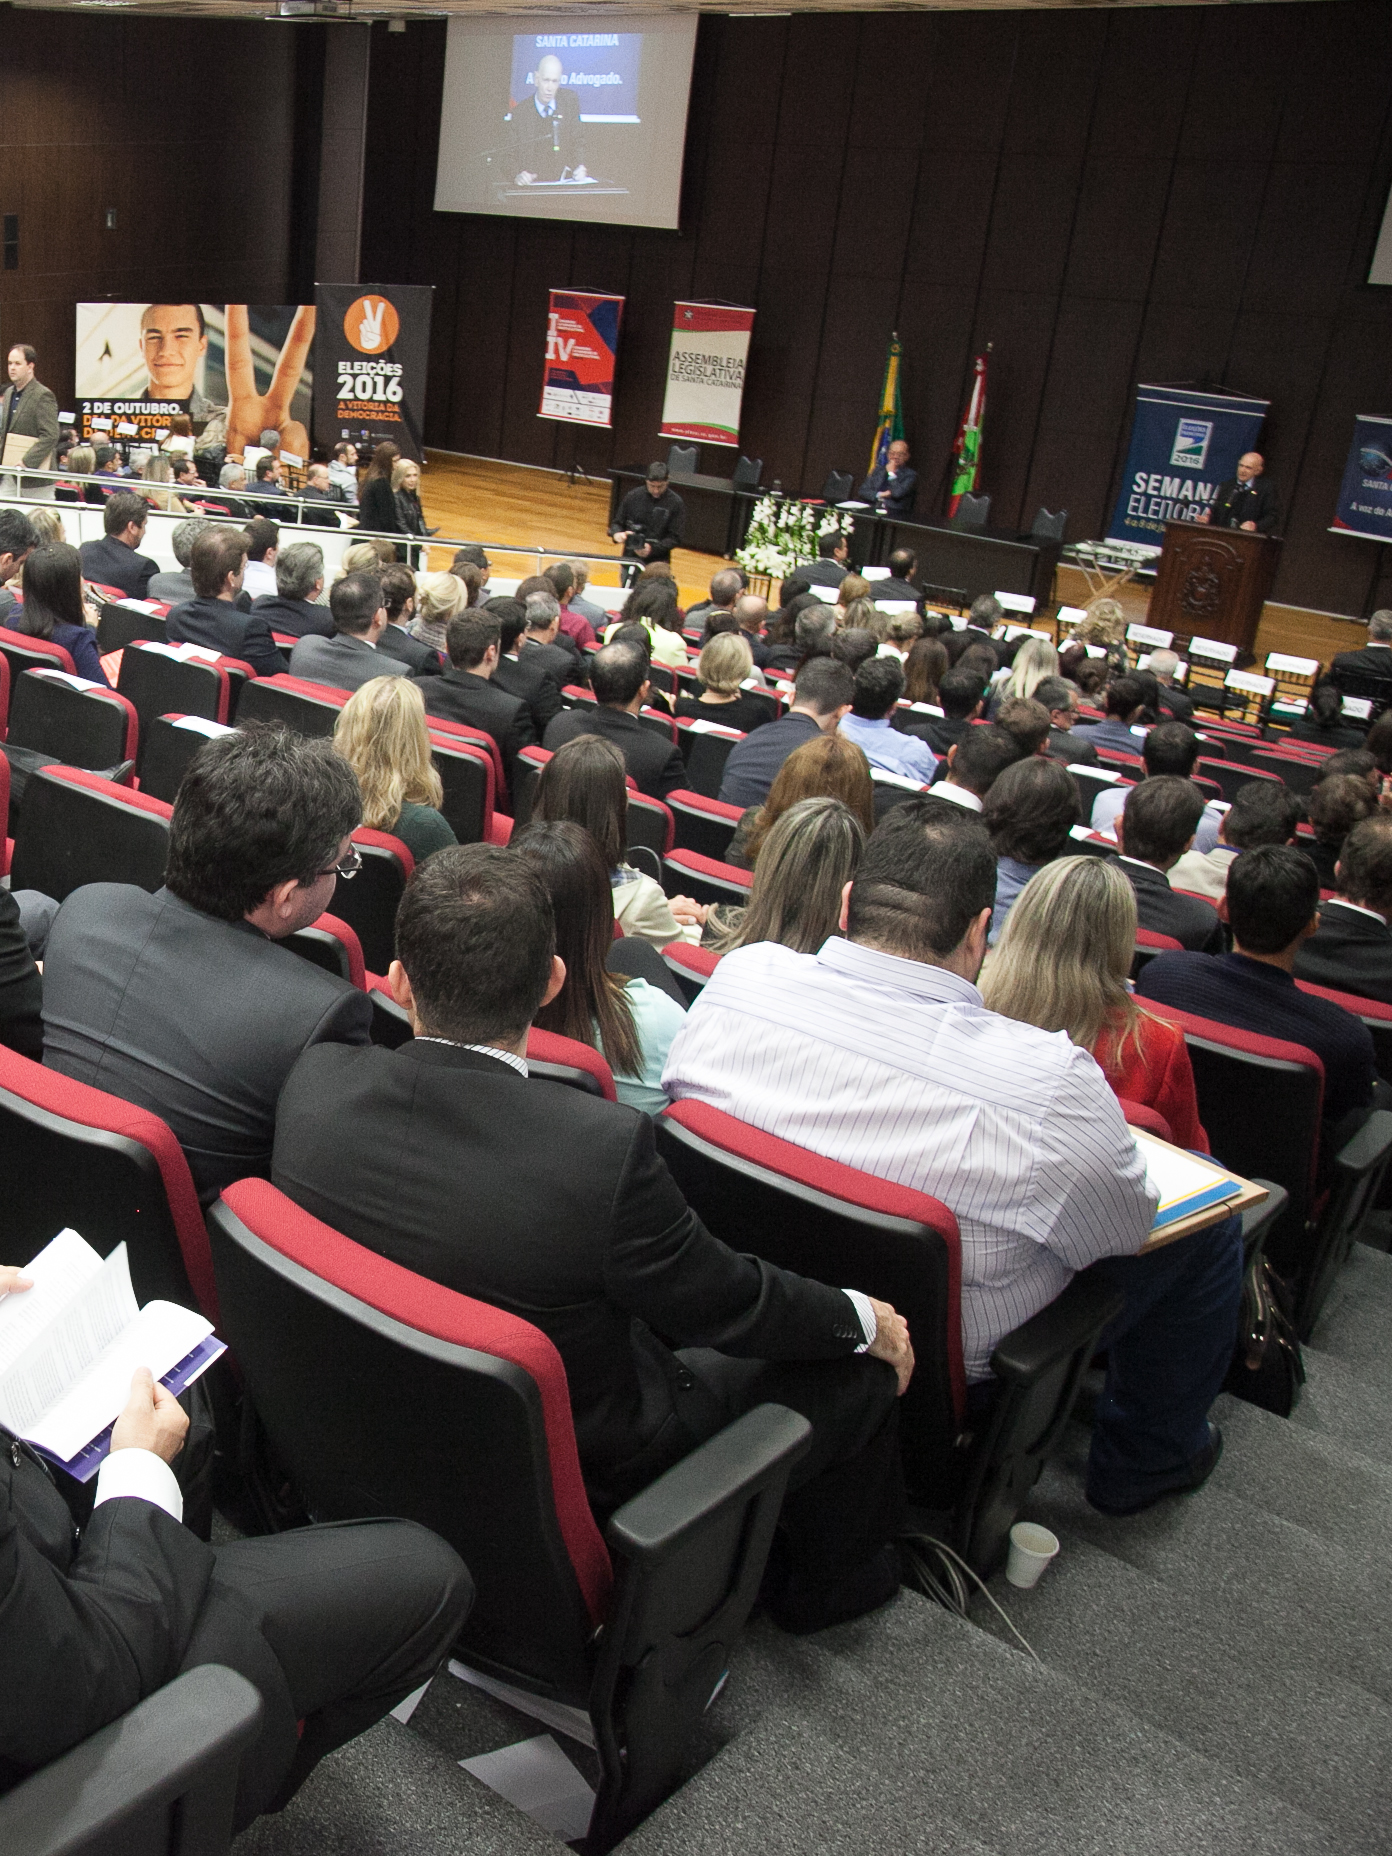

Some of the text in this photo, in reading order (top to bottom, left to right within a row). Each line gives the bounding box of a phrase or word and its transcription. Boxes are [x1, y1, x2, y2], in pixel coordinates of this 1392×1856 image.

[535, 34, 619, 47] SANTA CATARINA
[569, 71, 623, 87] Advogado.
[545, 336, 576, 361] IV
[672, 351, 744, 369] ASSEMBLEIA
[338, 359, 403, 377] ELEIÇÕES
[671, 362, 743, 380] LEGISLATIVA
[336, 374, 404, 402] 2016
[681, 375, 704, 384] SANTA
[706, 379, 743, 389] CATARINA
[82, 402, 183, 414] 2 DE OUTUBRO.
[338, 400, 400, 412] A VITÓRIA DA
[131, 414, 172, 426] VITÓR
[337, 410, 402, 422] DEMOCRACIA.
[1173, 454, 1200, 465] 2016
[1362, 479, 1388, 490] SANTA
[1127, 494, 1211, 521] ELEITORA
[1349, 501, 1357, 510] A
